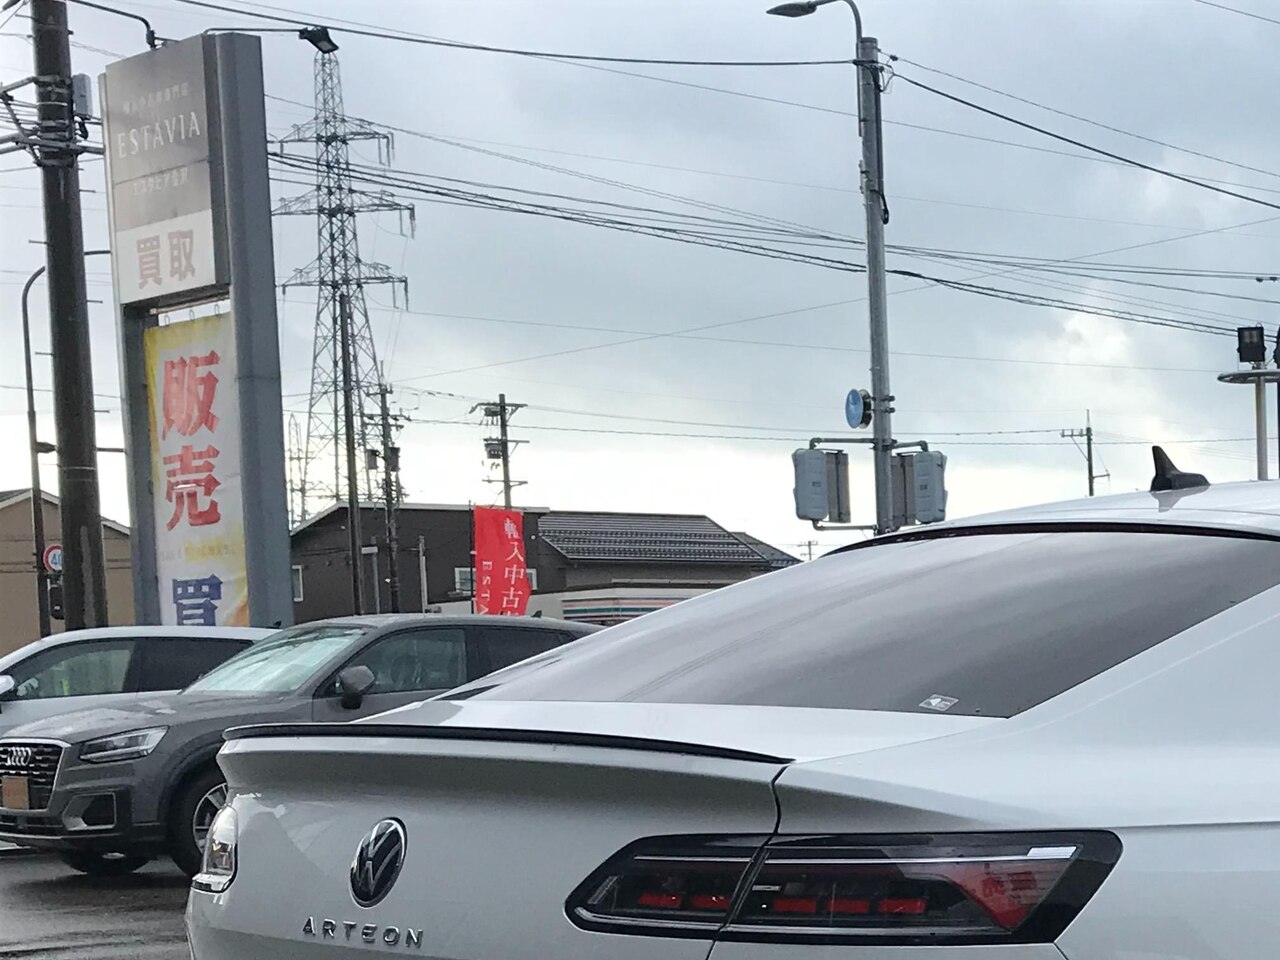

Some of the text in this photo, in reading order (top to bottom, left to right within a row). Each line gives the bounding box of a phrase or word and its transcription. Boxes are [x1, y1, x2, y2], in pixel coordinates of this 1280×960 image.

[117, 111, 200, 158] ESTAVIA
[136, 230, 195, 290] 買取
[162, 350, 221, 532] 販売
[501, 517, 525, 616] 輸入中古
[302, 916, 424, 949] ARTEON
